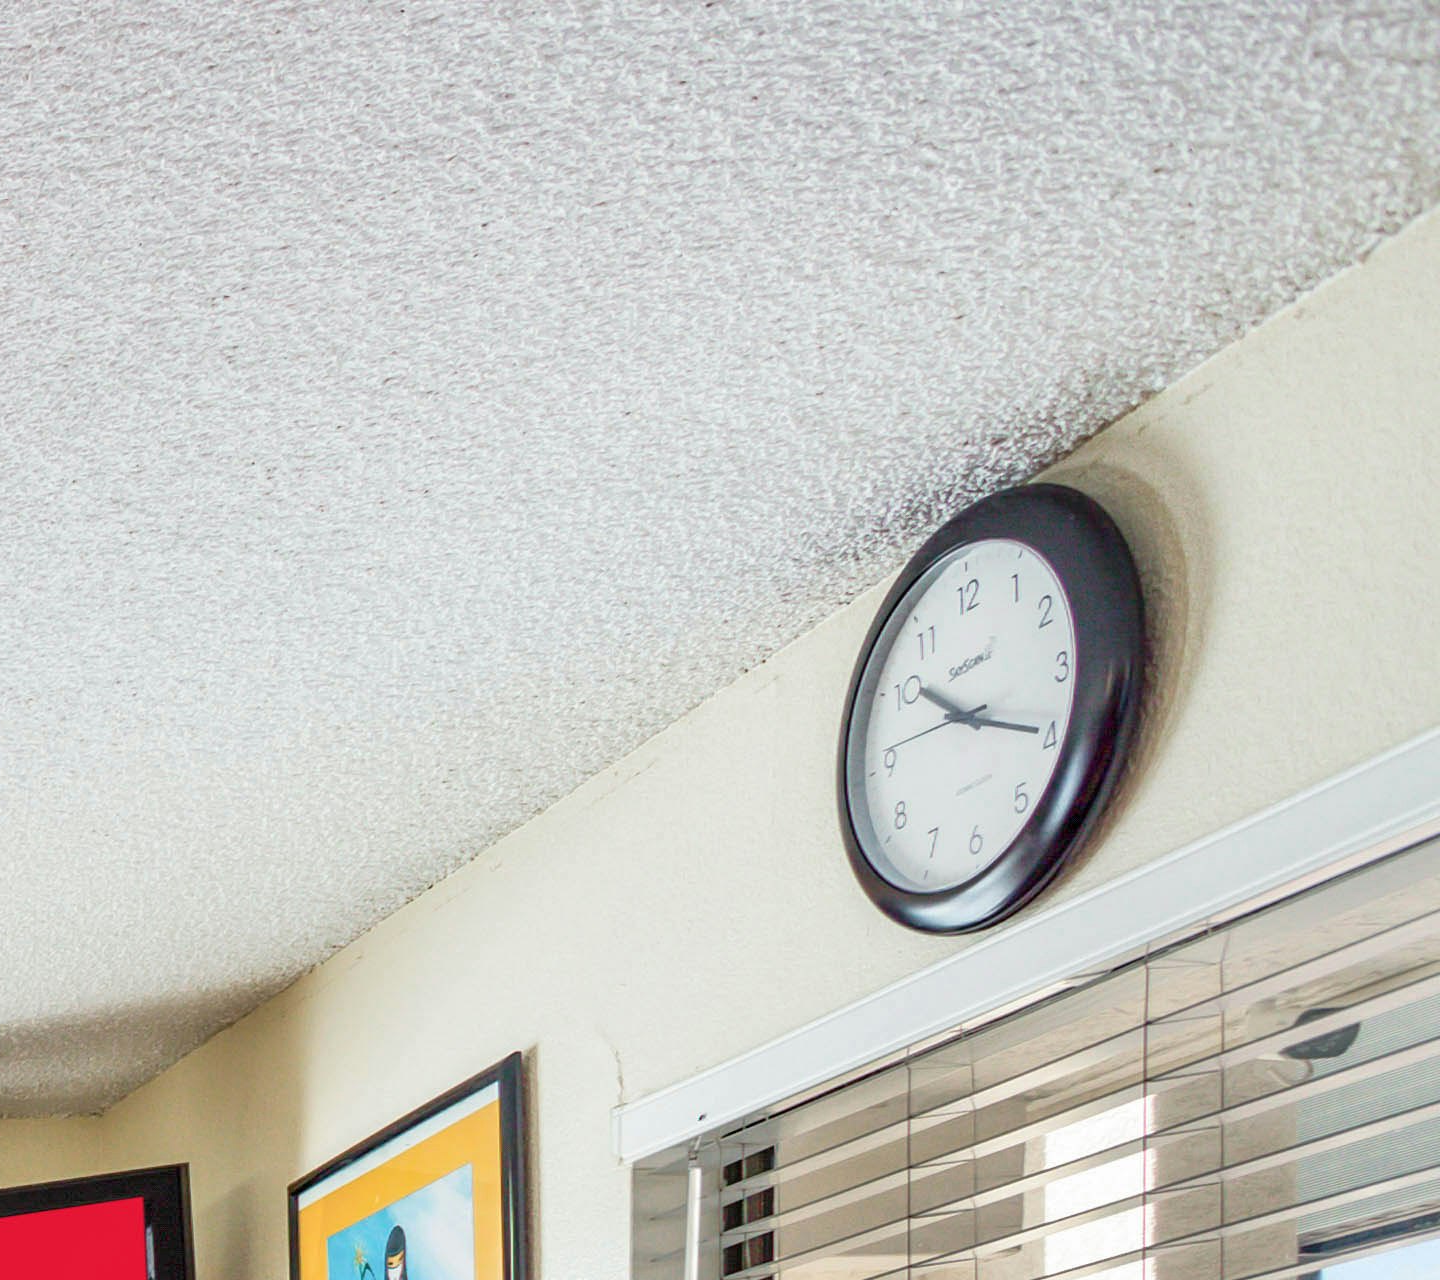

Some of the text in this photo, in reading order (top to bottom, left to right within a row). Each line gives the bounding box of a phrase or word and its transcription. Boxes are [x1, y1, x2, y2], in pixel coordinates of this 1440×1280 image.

[956, 578, 980, 616] 12
[1011, 573, 1020, 603] 1
[1037, 594, 1054, 629] 2
[916, 625, 937, 661] 11
[1054, 651, 1071, 684] 3
[893, 674, 923, 712] 10
[1042, 720, 1058, 751] 4
[883, 748, 898, 778] 9
[1013, 782, 1029, 814] 5
[893, 800, 908, 830] 8
[927, 826, 939, 859] 7
[967, 824, 984, 855] 6
